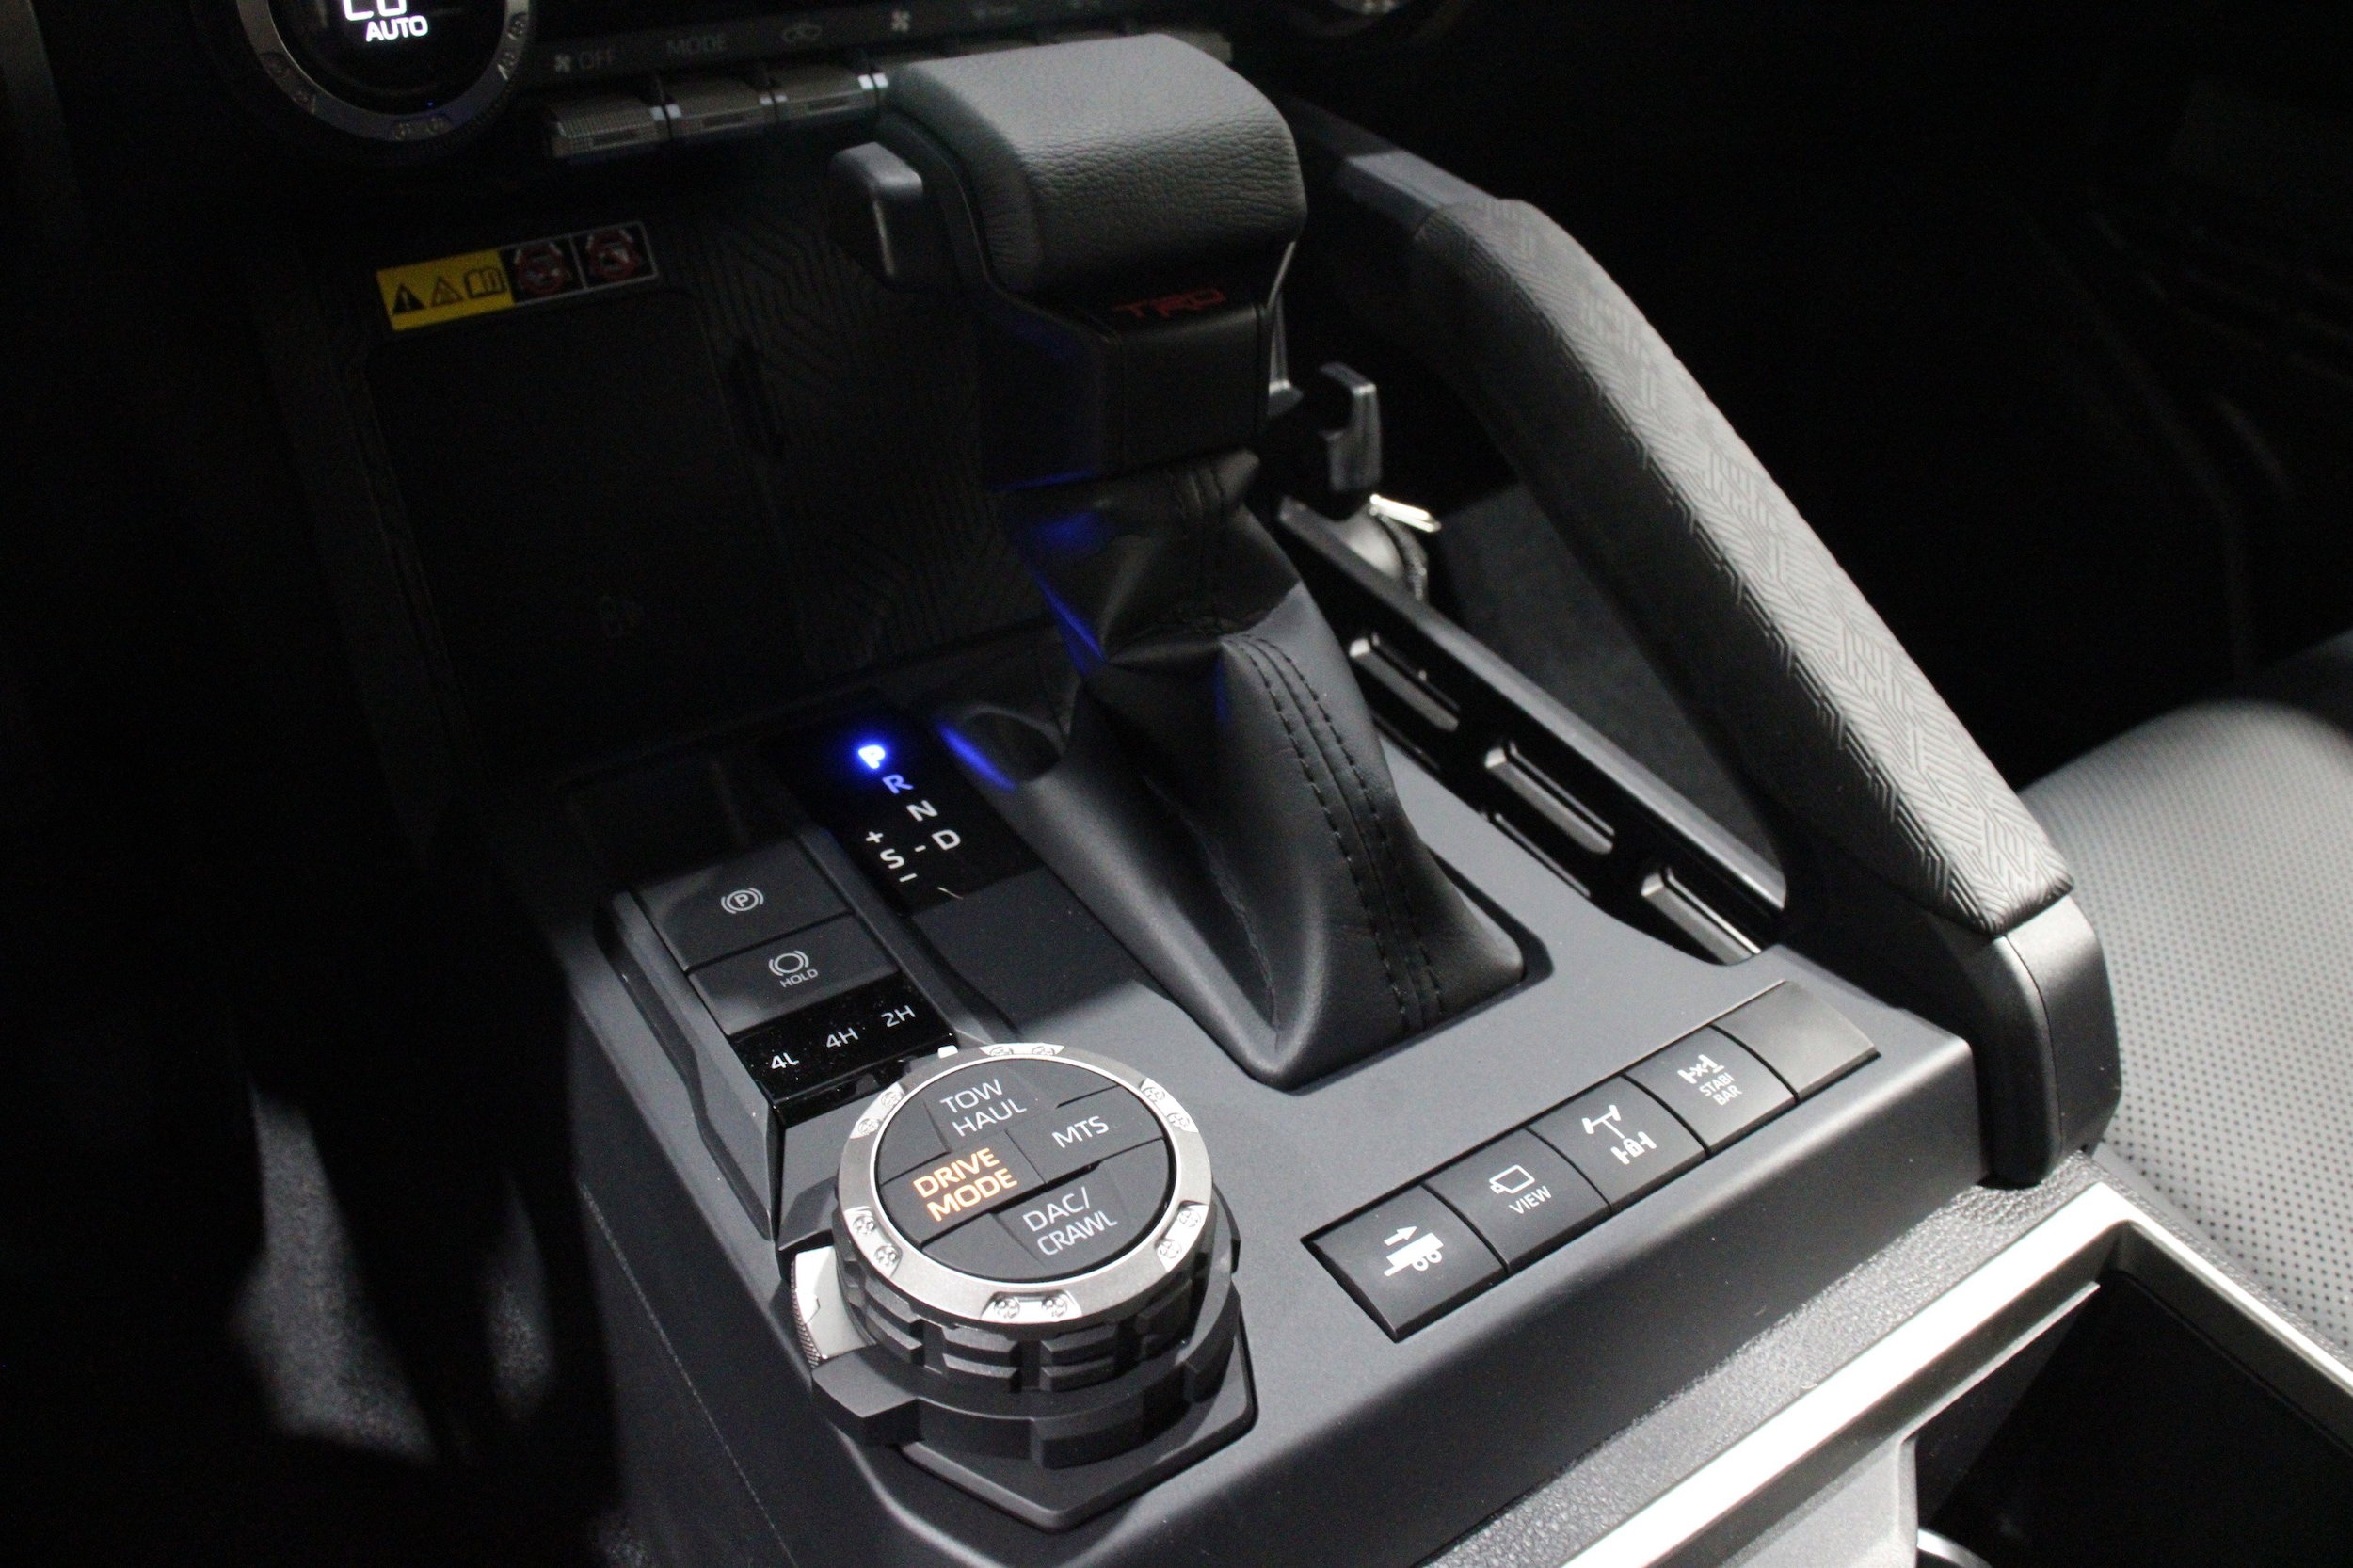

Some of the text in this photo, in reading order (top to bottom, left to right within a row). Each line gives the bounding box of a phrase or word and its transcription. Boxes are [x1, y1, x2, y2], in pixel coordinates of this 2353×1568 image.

[365, 15, 428, 42] AUTO
[666, 32, 728, 57] MODE
[1112, 287, 1225, 320] TRD
[858, 744, 886, 769] P
[882, 773, 915, 795] R
[905, 799, 939, 823] N
[879, 848, 905, 870] S
[931, 828, 962, 851] D
[779, 968, 819, 988] HOLD
[771, 1004, 917, 1071] 4L 4H 2H
[938, 1078, 1004, 1115] TOW
[1699, 1072, 1736, 1096] STABI
[1712, 1084, 1743, 1106] BAR
[951, 1097, 1028, 1138] HAUL
[1051, 1114, 1110, 1150] MTS
[912, 1146, 1000, 1200] DRIVE
[925, 1167, 1018, 1223] MODE
[1022, 1185, 1092, 1233] DAC/
[1508, 1184, 1553, 1215] VIEW
[1036, 1209, 1119, 1257] CRAWL
